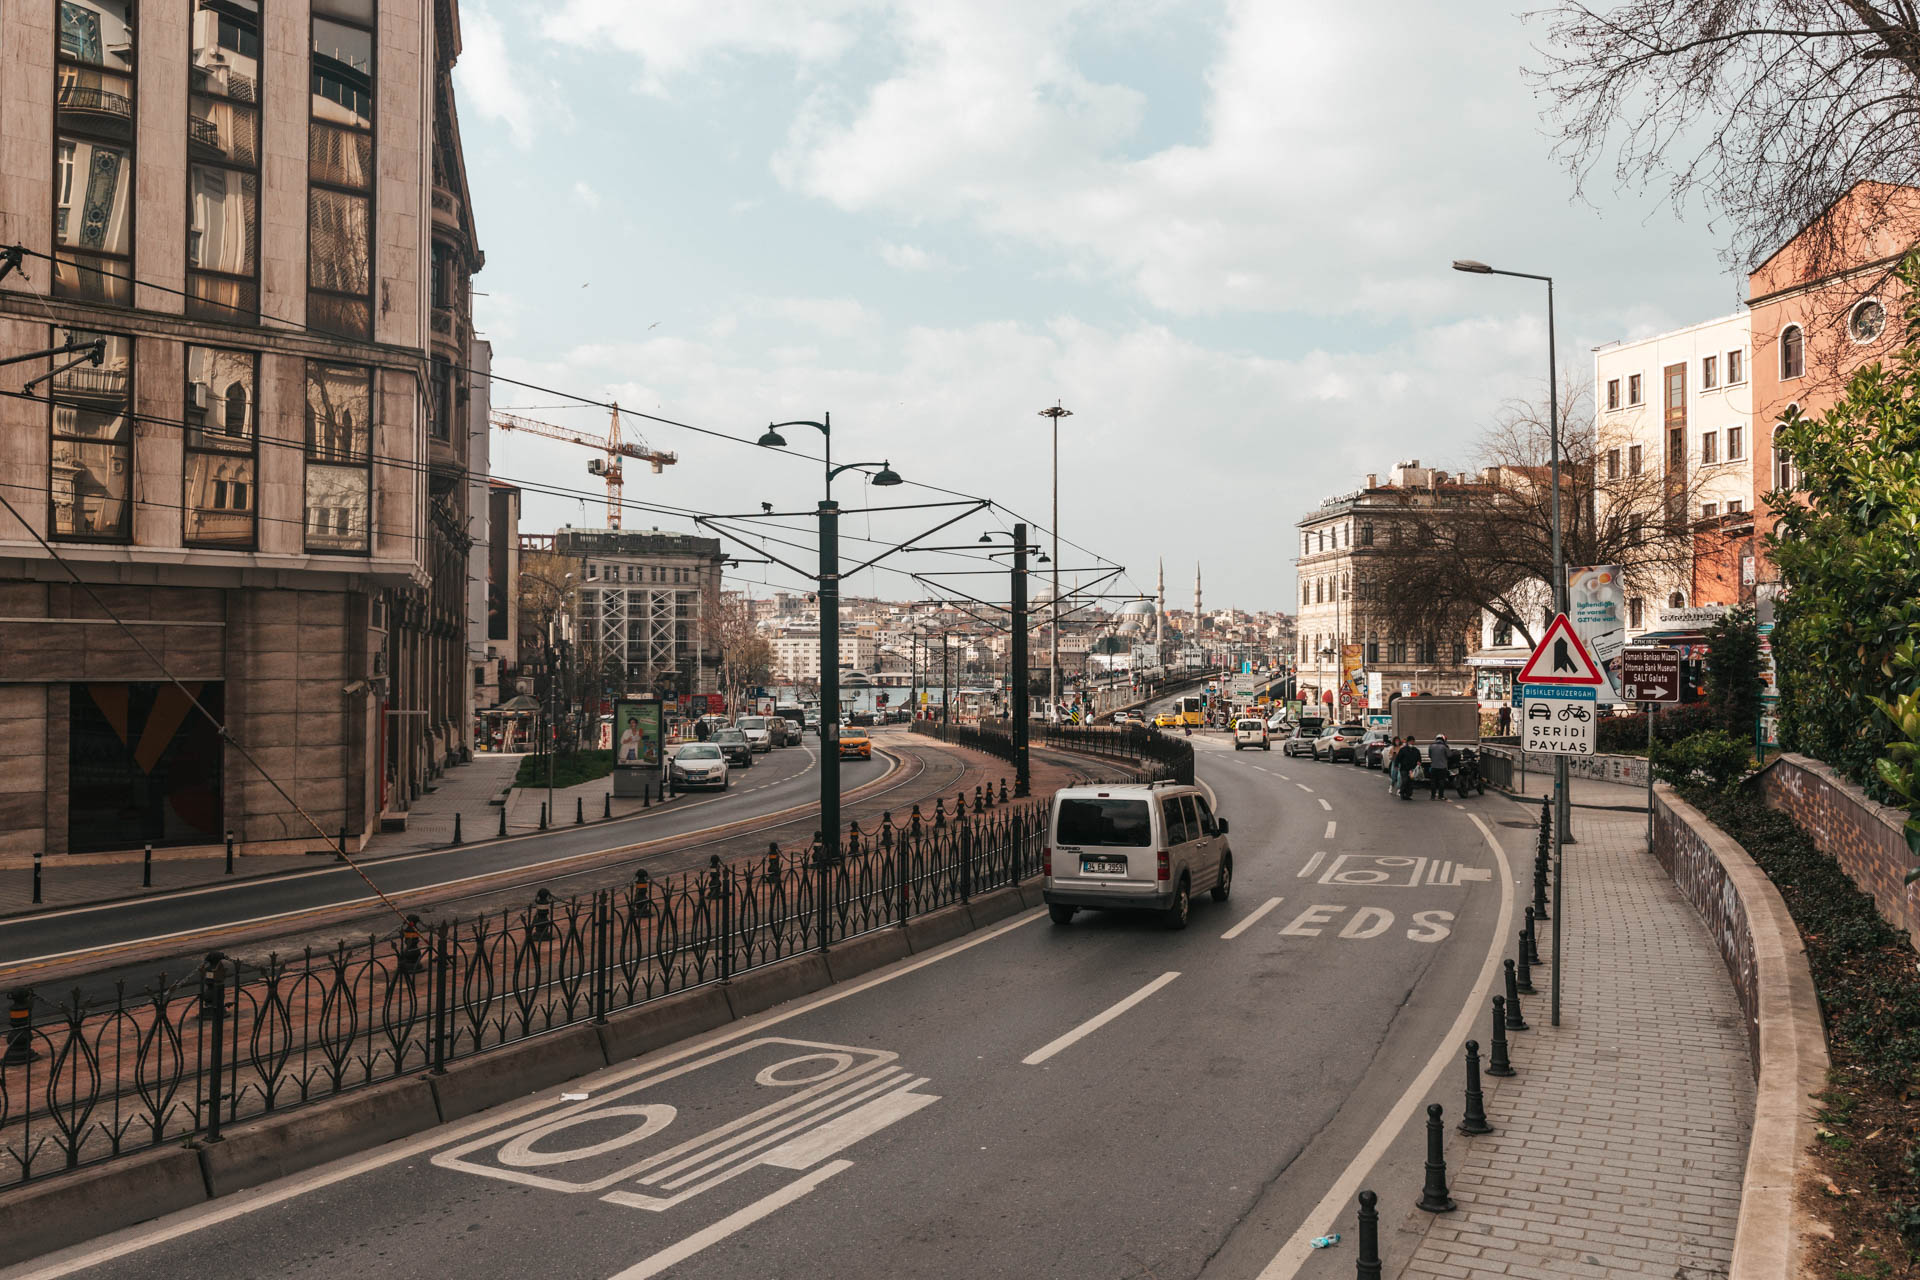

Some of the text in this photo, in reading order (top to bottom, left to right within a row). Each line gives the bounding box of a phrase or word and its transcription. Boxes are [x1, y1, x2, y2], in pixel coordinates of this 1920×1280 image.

[1624, 652, 1677, 661] Osmanlı Bankası Müzesi
[1624, 663, 1677, 672] Ottoman Bank Museum
[1634, 674, 1668, 682] SALT Galata
[1532, 724, 1586, 738] ŞERİDİ
[1529, 740, 1587, 753] PAYLAŞ
[1278, 904, 1456, 942] EDS
